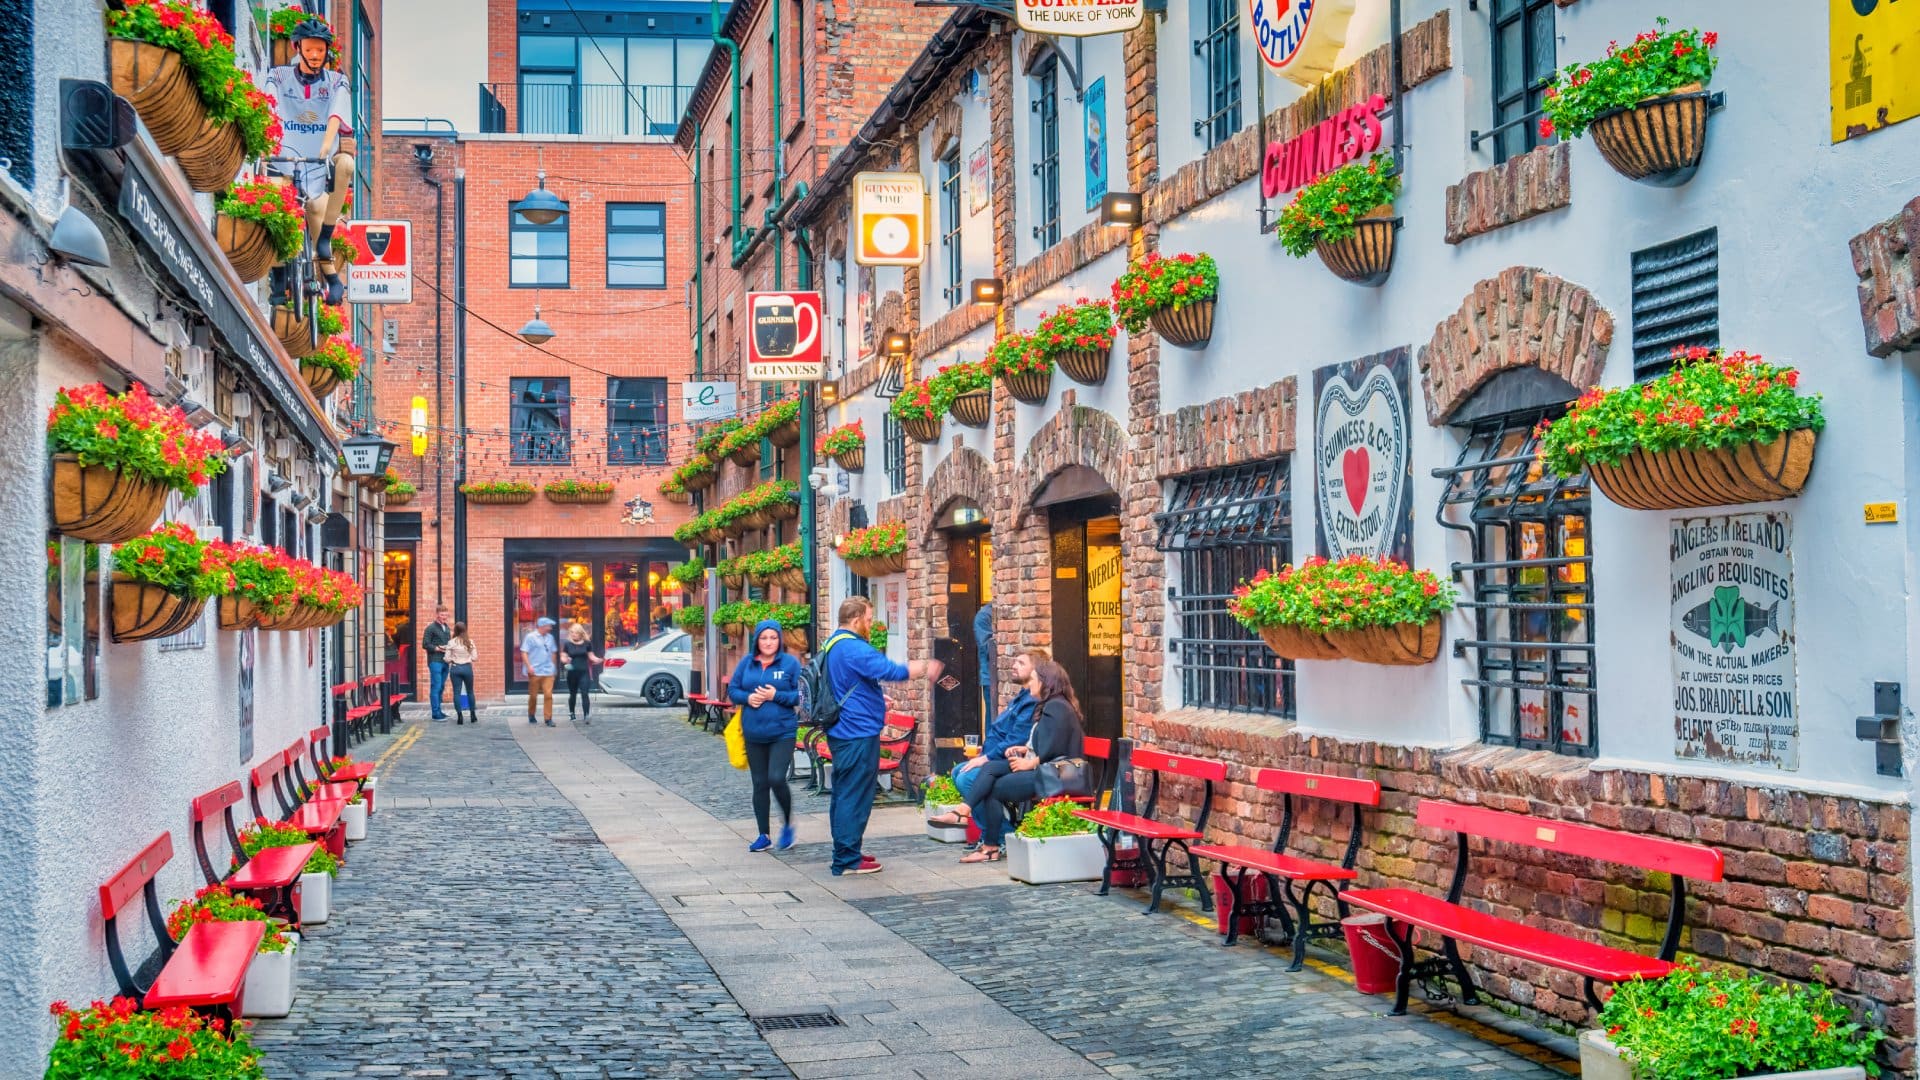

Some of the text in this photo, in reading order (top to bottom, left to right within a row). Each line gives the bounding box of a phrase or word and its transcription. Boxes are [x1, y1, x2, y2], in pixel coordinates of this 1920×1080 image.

[1027, 7, 1136, 22] THE DUKE OF YORK
[1263, 94, 1385, 198] GUINNESS
[865, 184, 913, 193] GUINNESS
[876, 194, 904, 204] TIME
[351, 270, 406, 279] GUINNESS
[369, 284, 389, 294] BAR
[753, 364, 818, 375] GUINNESS
[1324, 419, 1365, 468] GUINNESS
[1367, 421, 1375, 447] &
[1336, 505, 1384, 542] EXTRA STOUT.
[1673, 522, 1785, 559] ANGLERS IN IRELAND
[1699, 546, 1754, 561] OBTAIN YOUR
[1671, 562, 1788, 605] ANGLING REQUISITES
[1675, 640, 1789, 669] ROM THE ACTUAL MAKERS
[1680, 671, 1783, 686] AT LOWEST CASH PRICES
[1675, 686, 1698, 712] JOS.
[1699, 686, 1757, 716] BRADDELL
[1765, 691, 1793, 719] SON
[1720, 733, 1740, 747] 1811.
